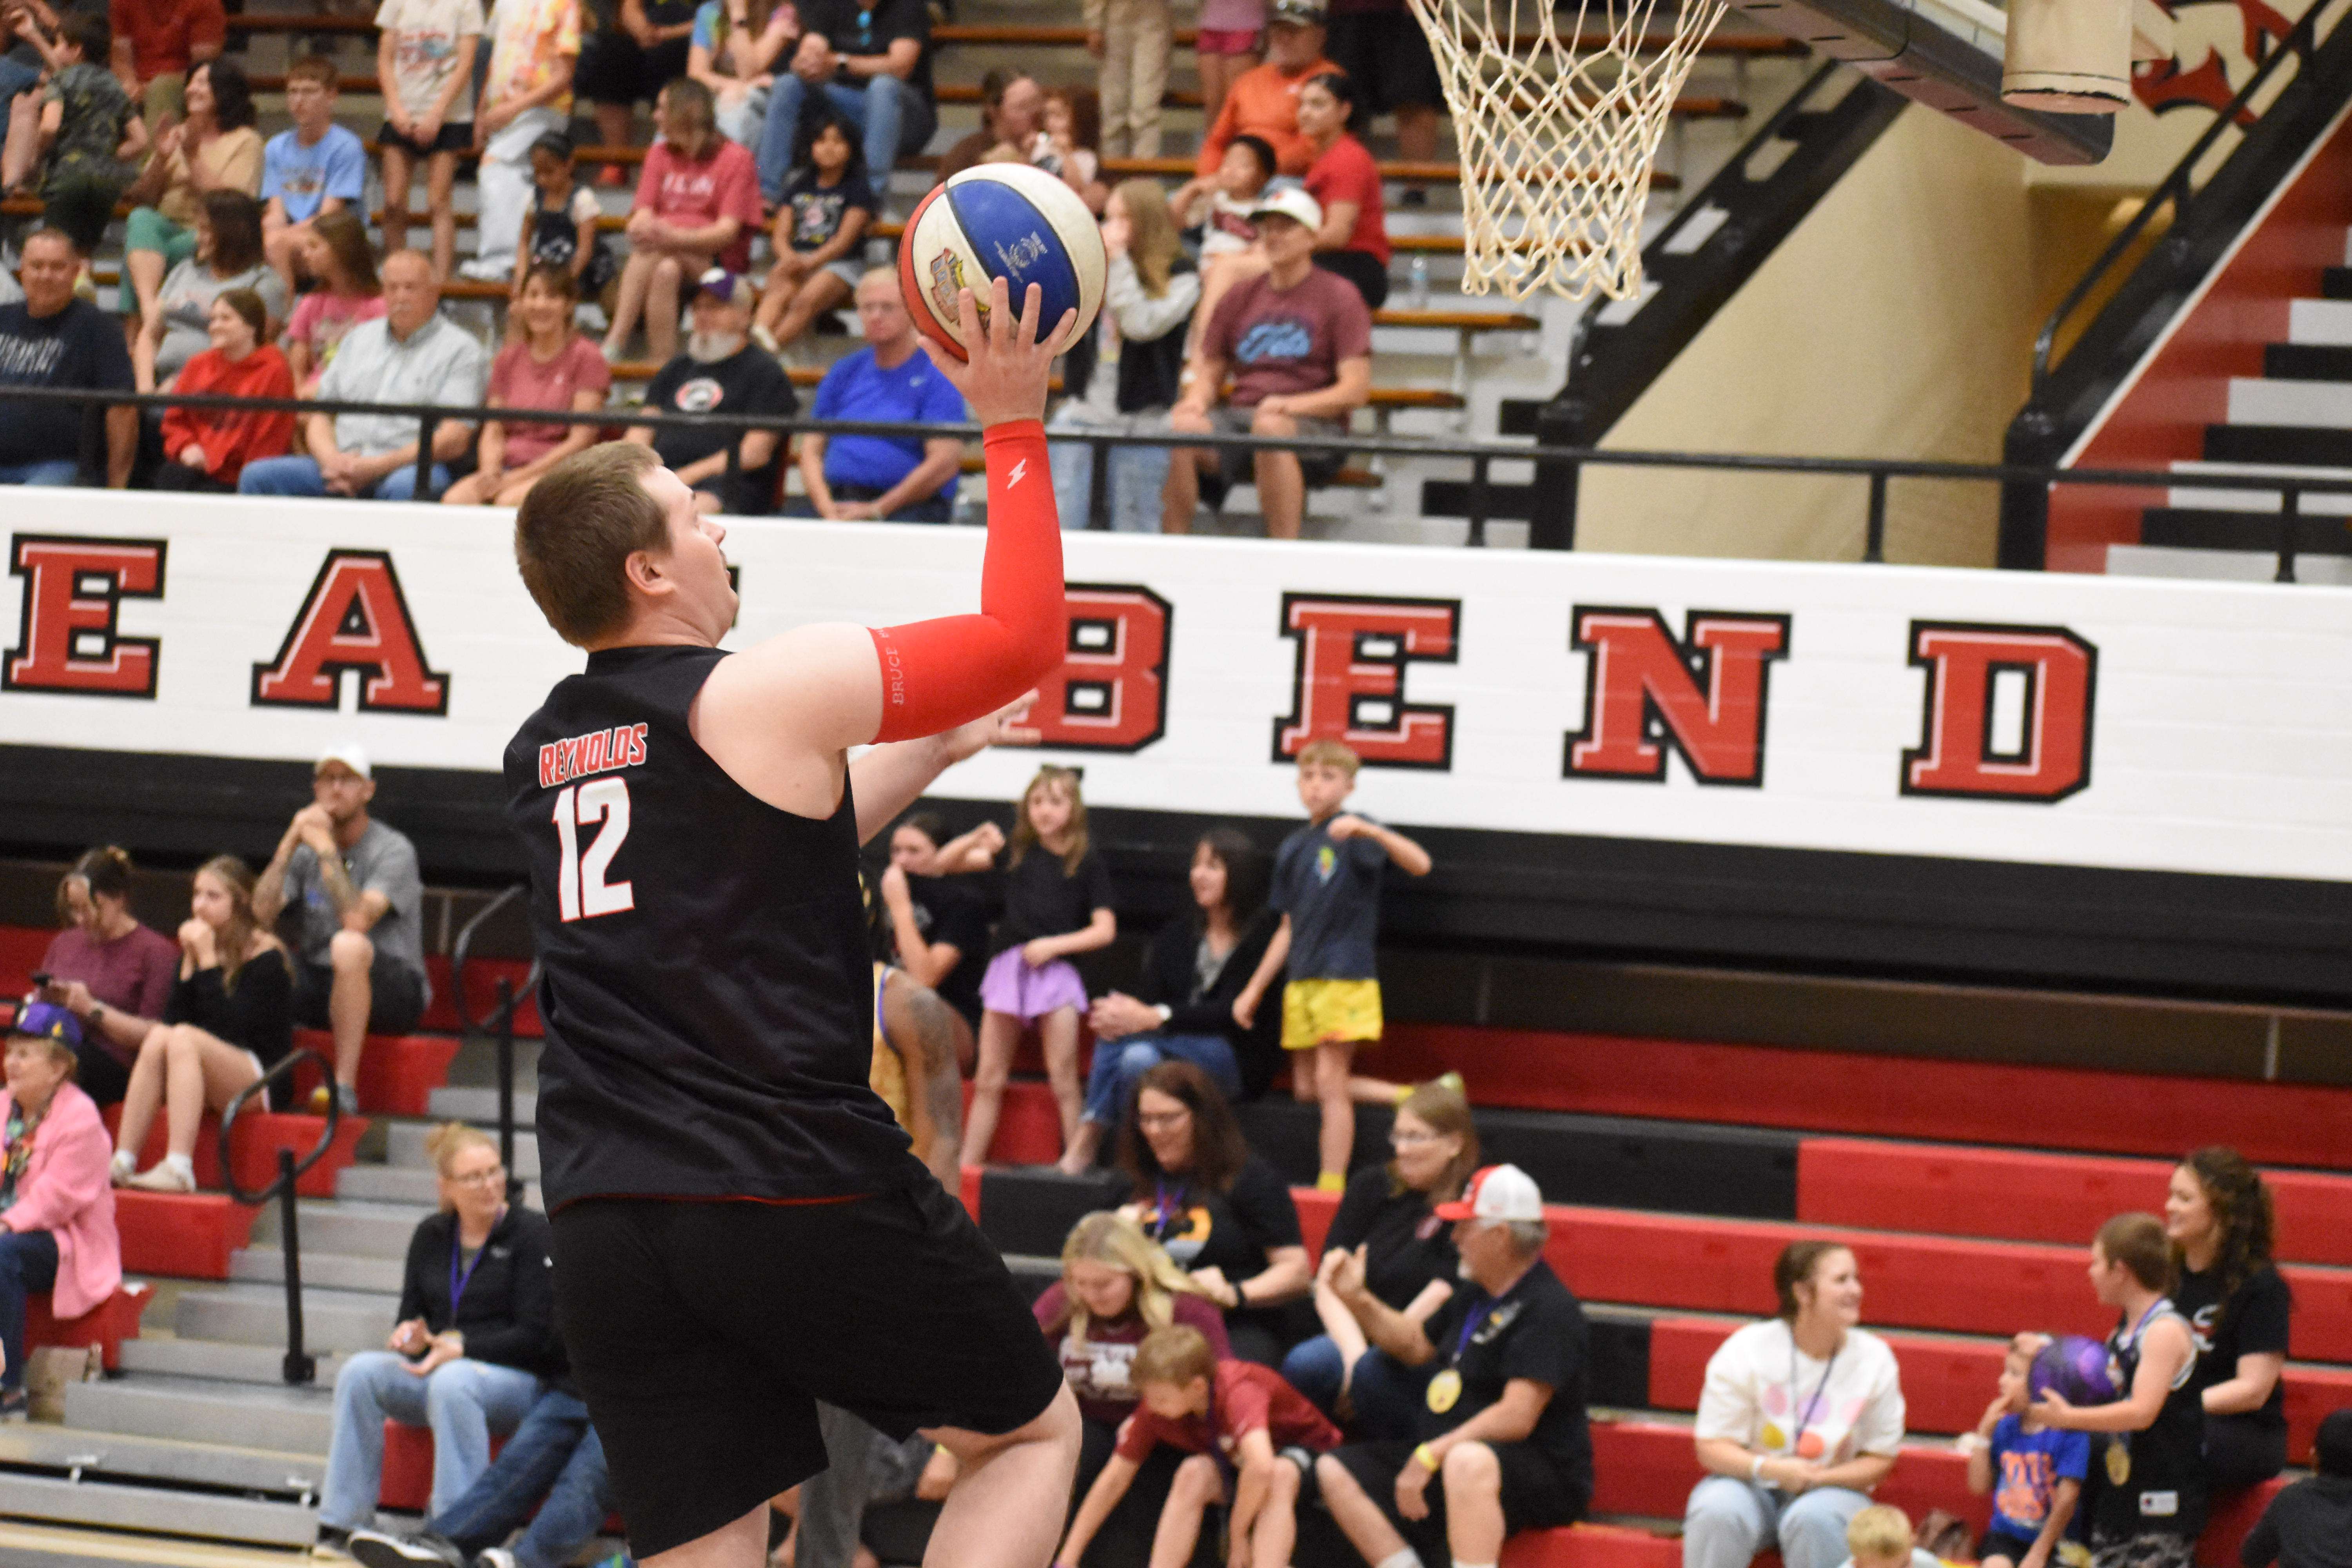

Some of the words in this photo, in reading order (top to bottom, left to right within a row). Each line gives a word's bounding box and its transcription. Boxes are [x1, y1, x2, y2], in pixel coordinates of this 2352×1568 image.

[539, 722, 648, 789] REYNOLDS
[989, 583, 2099, 804] BEND
[551, 775, 635, 923] 12
